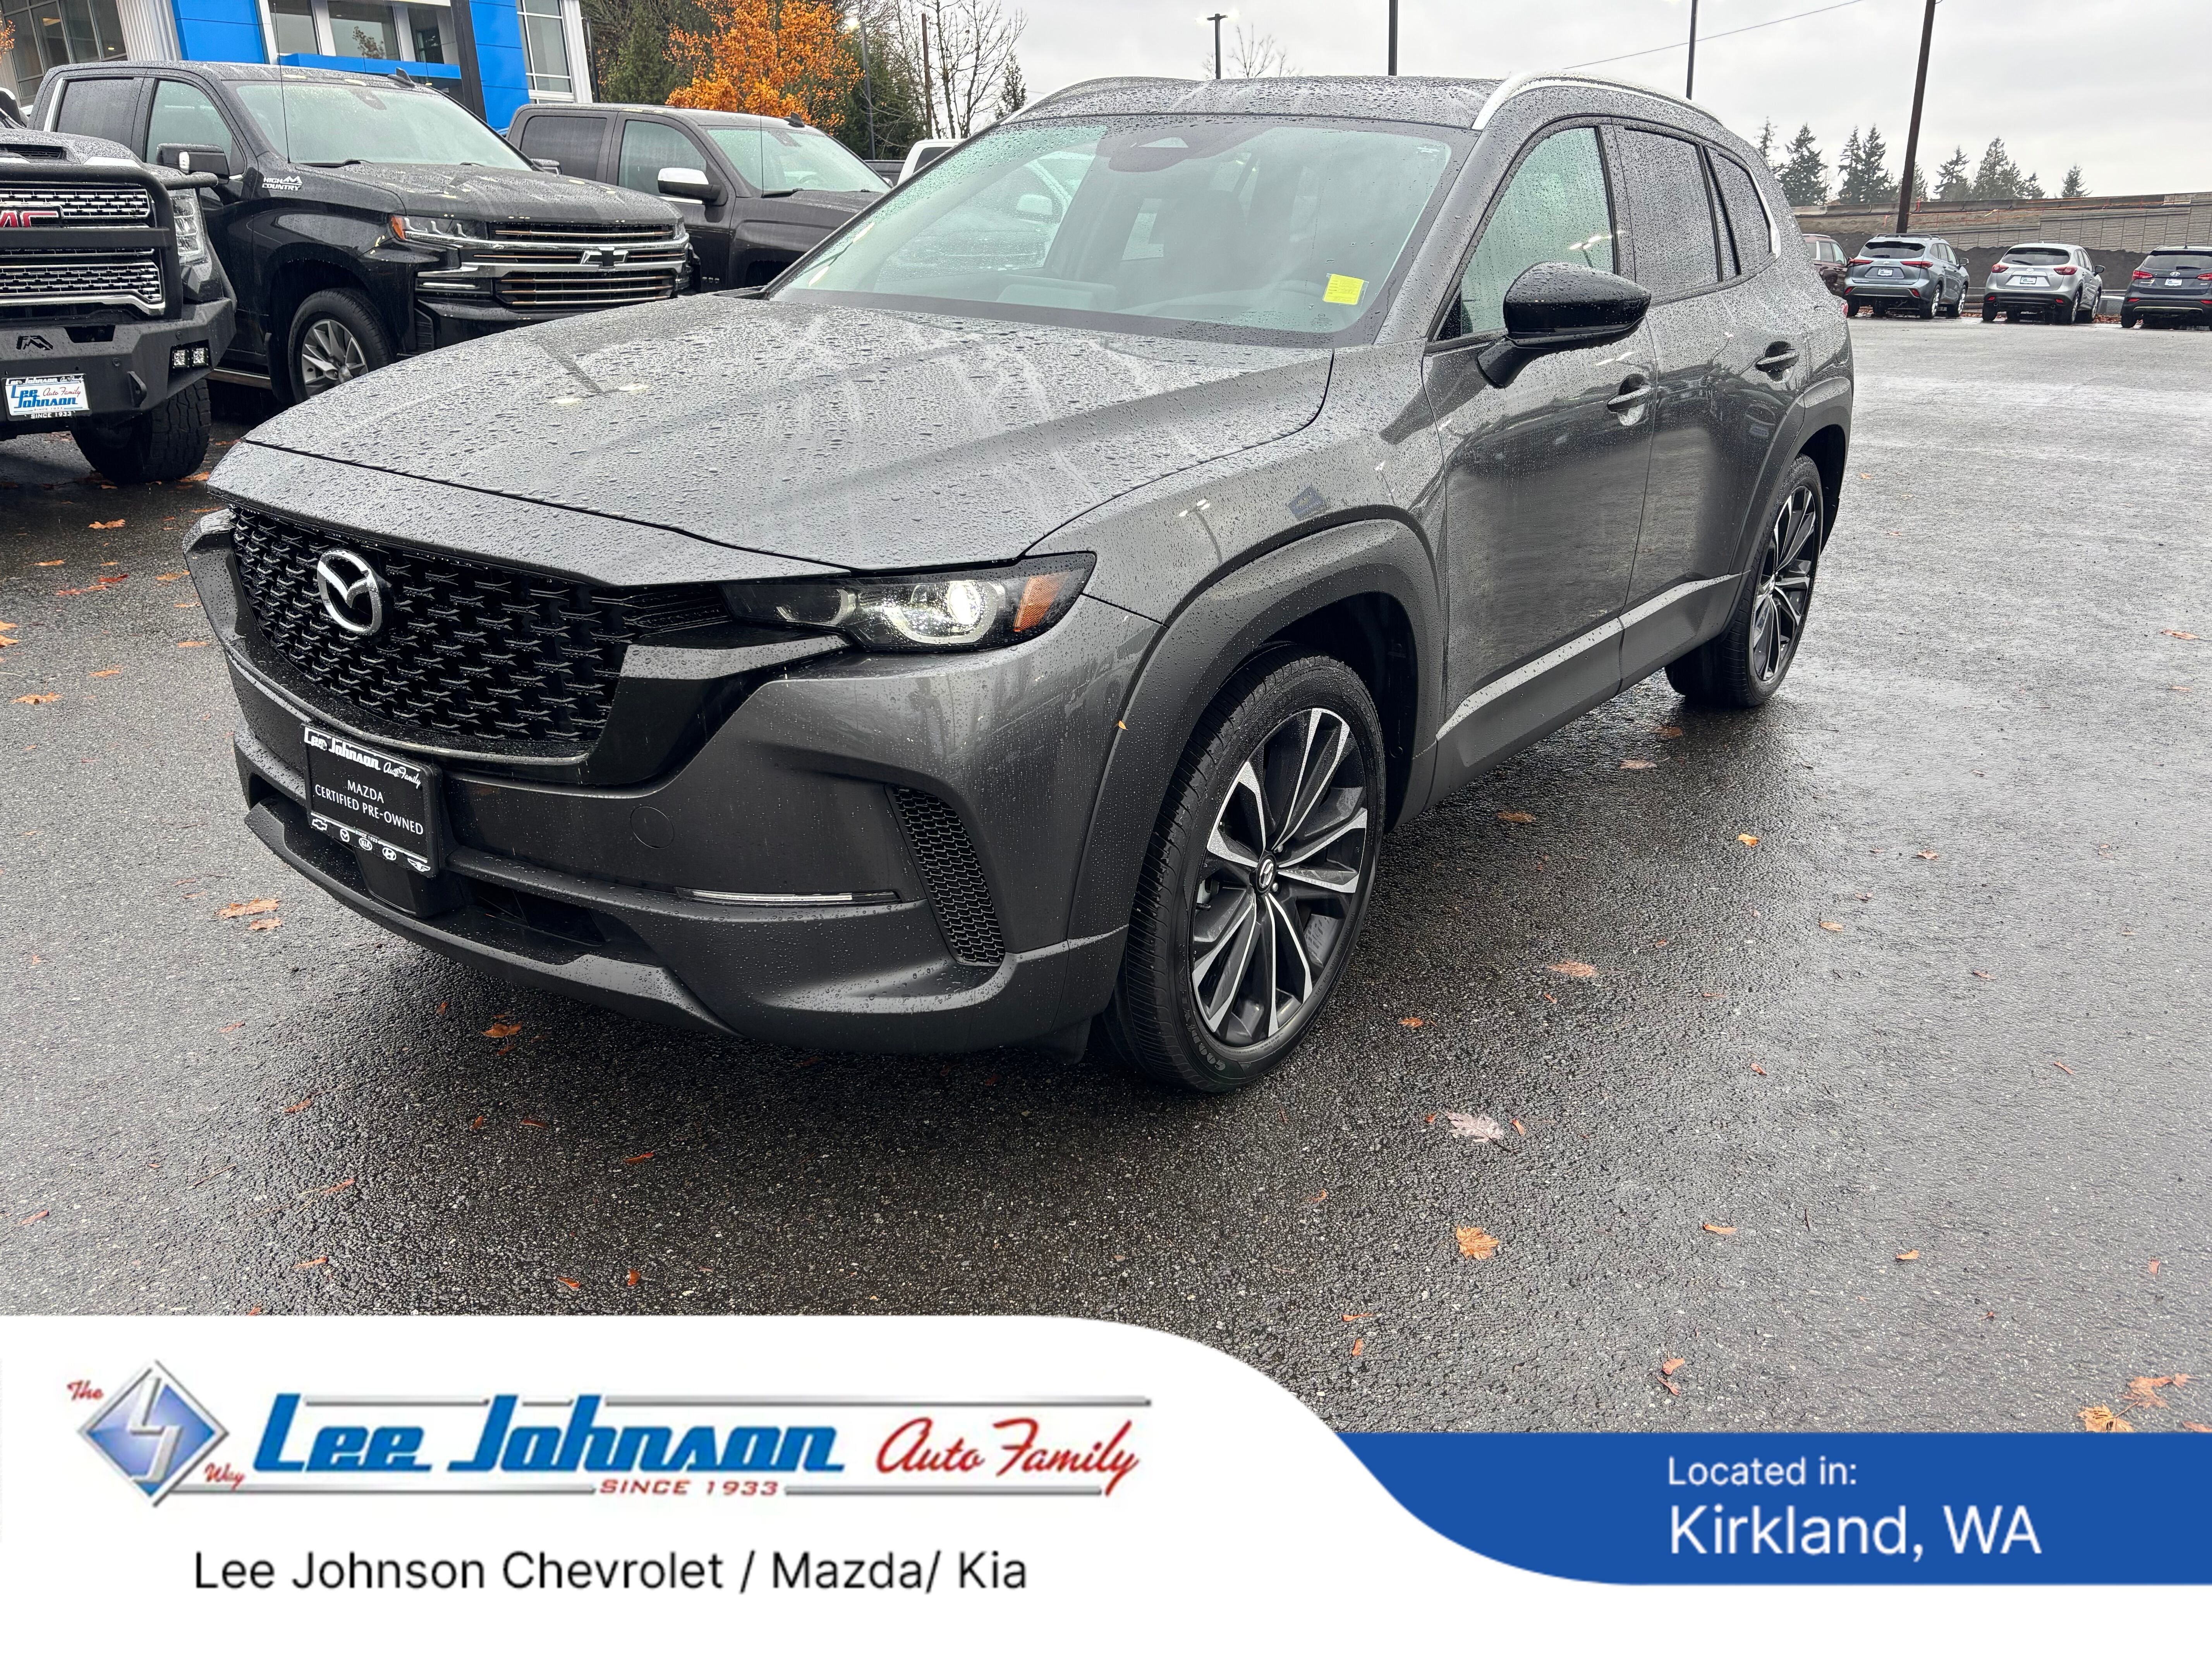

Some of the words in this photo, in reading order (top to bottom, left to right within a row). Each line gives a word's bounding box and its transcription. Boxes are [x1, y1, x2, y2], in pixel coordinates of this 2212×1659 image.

[11, 385, 40, 398] Lee
[43, 388, 59, 396] Auto
[59, 386, 81, 397] Family
[14, 392, 78, 409] Johnson
[328, 737, 381, 770] Johnson
[399, 766, 421, 789] Family
[347, 780, 384, 804] MAZDA
[315, 784, 359, 811] CERTIFIED
[362, 802, 424, 835] PRE-OWNED
